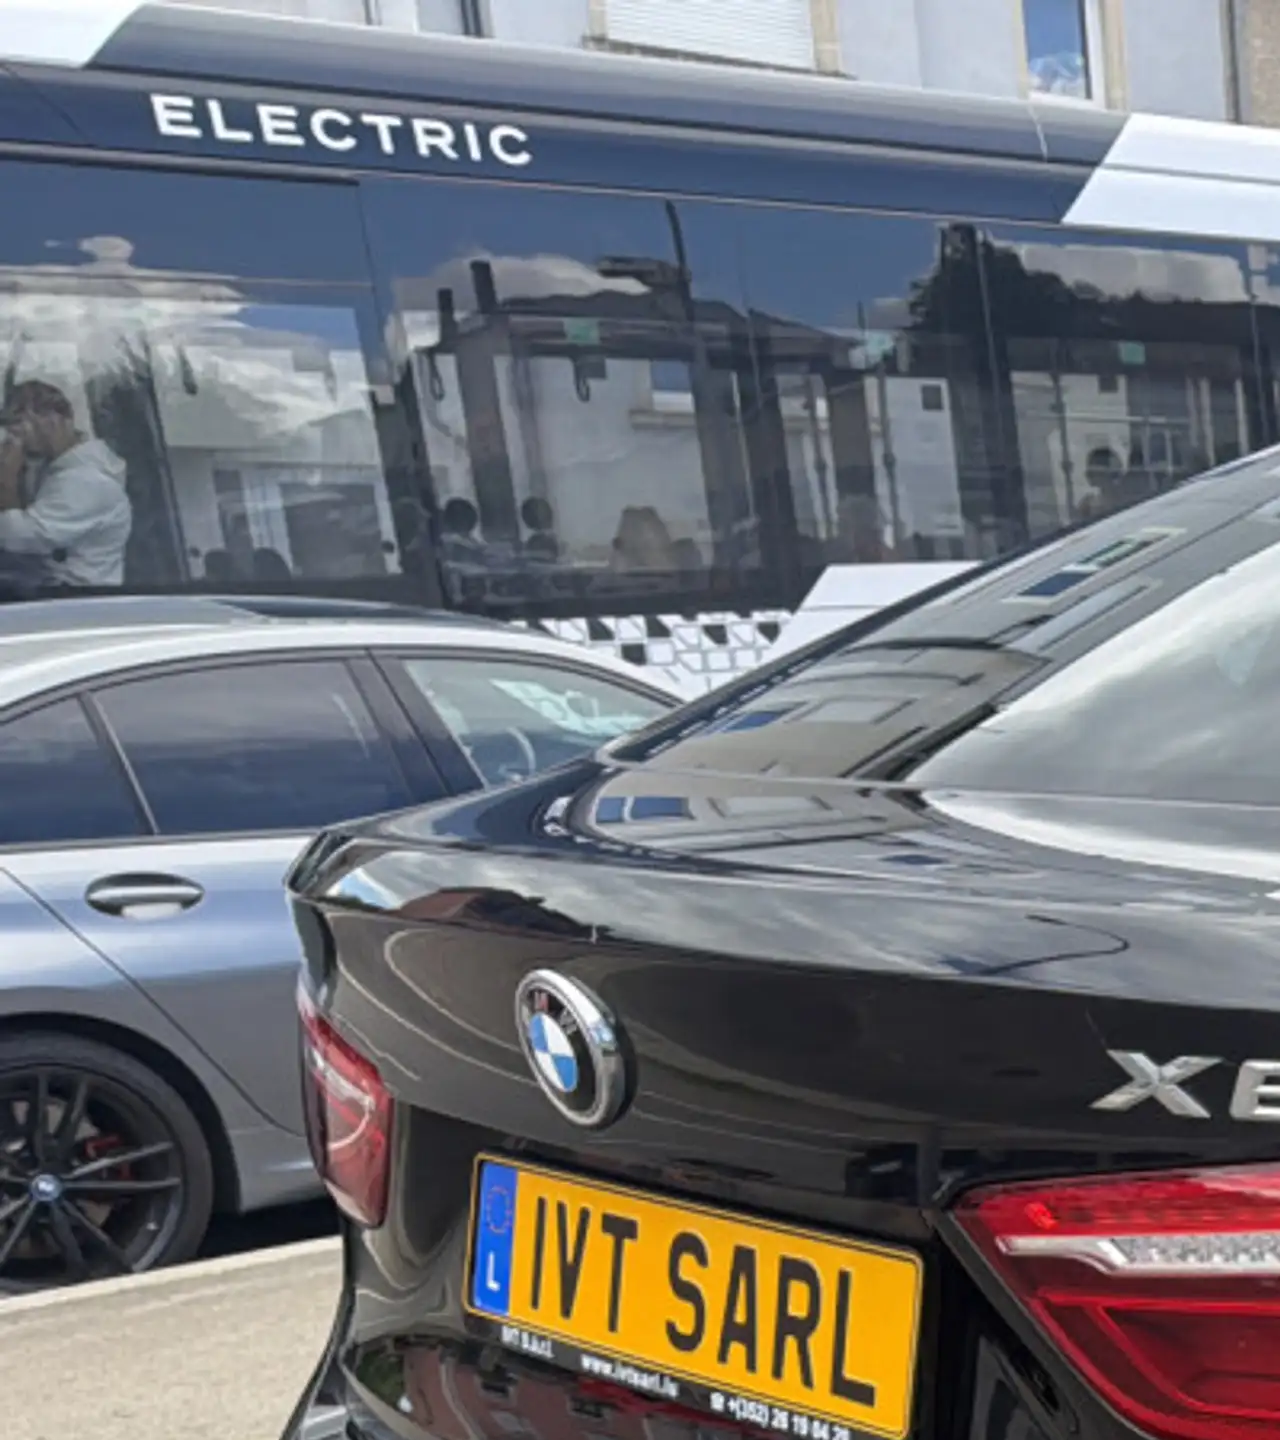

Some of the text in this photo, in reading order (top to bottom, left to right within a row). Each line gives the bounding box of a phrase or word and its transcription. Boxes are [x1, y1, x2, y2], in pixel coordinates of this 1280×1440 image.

[150, 93, 534, 166] ELECTRIC
[486, 1251, 501, 1291] L
[531, 1195, 876, 1409] IVT SARL
